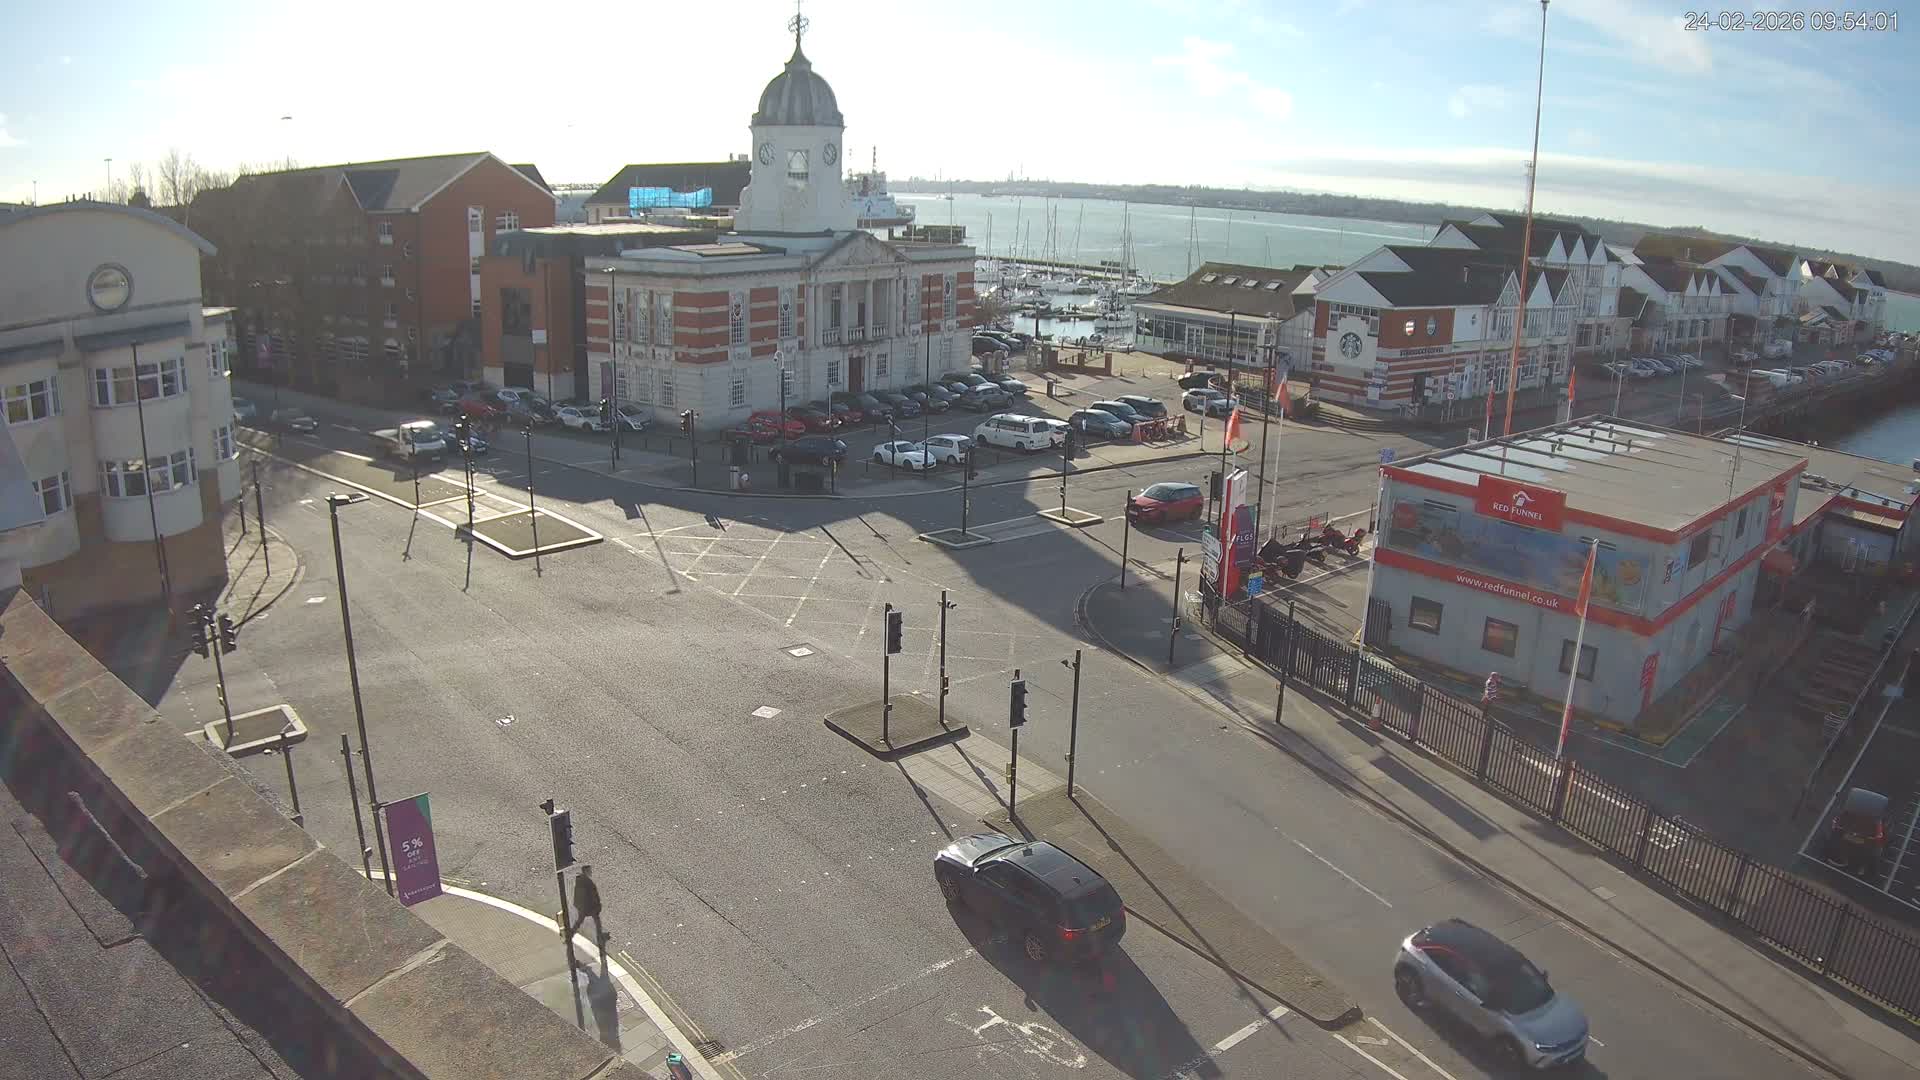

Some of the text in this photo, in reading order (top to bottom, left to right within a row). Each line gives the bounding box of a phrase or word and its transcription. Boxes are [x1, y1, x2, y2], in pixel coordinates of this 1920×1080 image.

[1493, 502, 1544, 521] RED FUNNEL
[1456, 574, 1559, 608] www.redfunnel.co.uk
